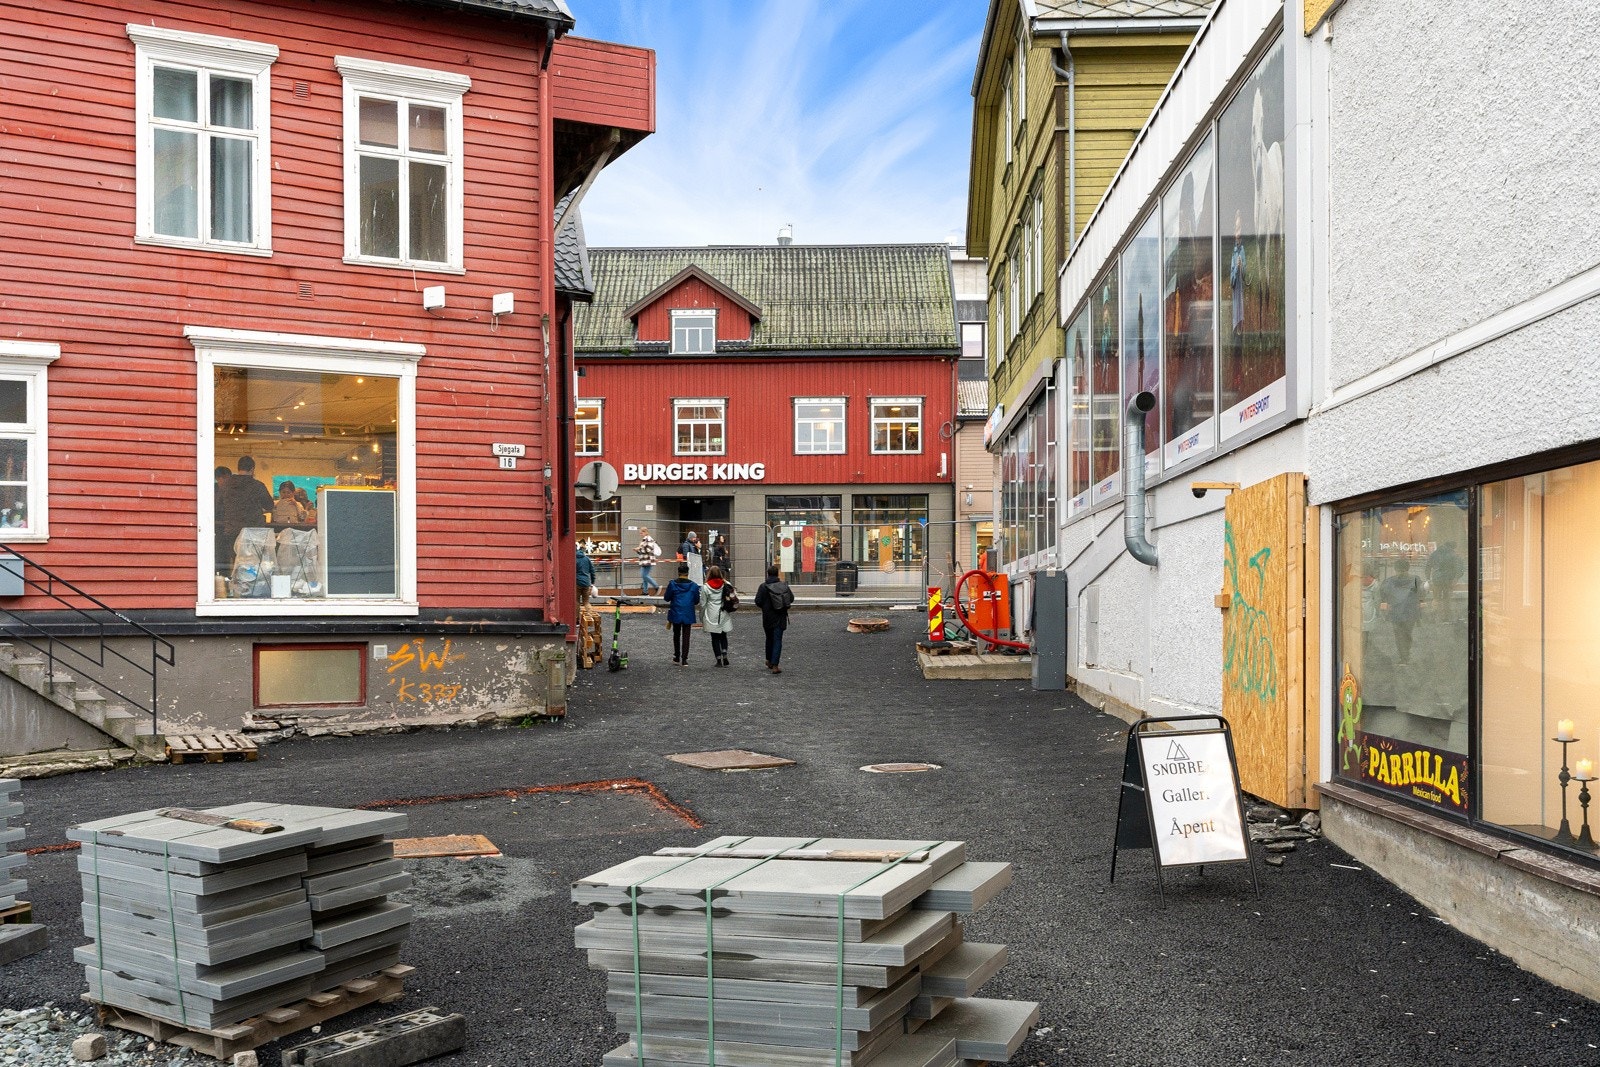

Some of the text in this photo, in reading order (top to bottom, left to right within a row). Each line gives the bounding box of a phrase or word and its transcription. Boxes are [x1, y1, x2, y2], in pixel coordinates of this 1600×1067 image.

[503, 457, 512, 468] 16
[624, 463, 765, 480] BURGER KING
[1152, 761, 1205, 776] SNORRE
[1368, 746, 1460, 805] PARRILLA
[1412, 785, 1442, 803] Mexican food
[1170, 817, 1215, 838] Åpent
